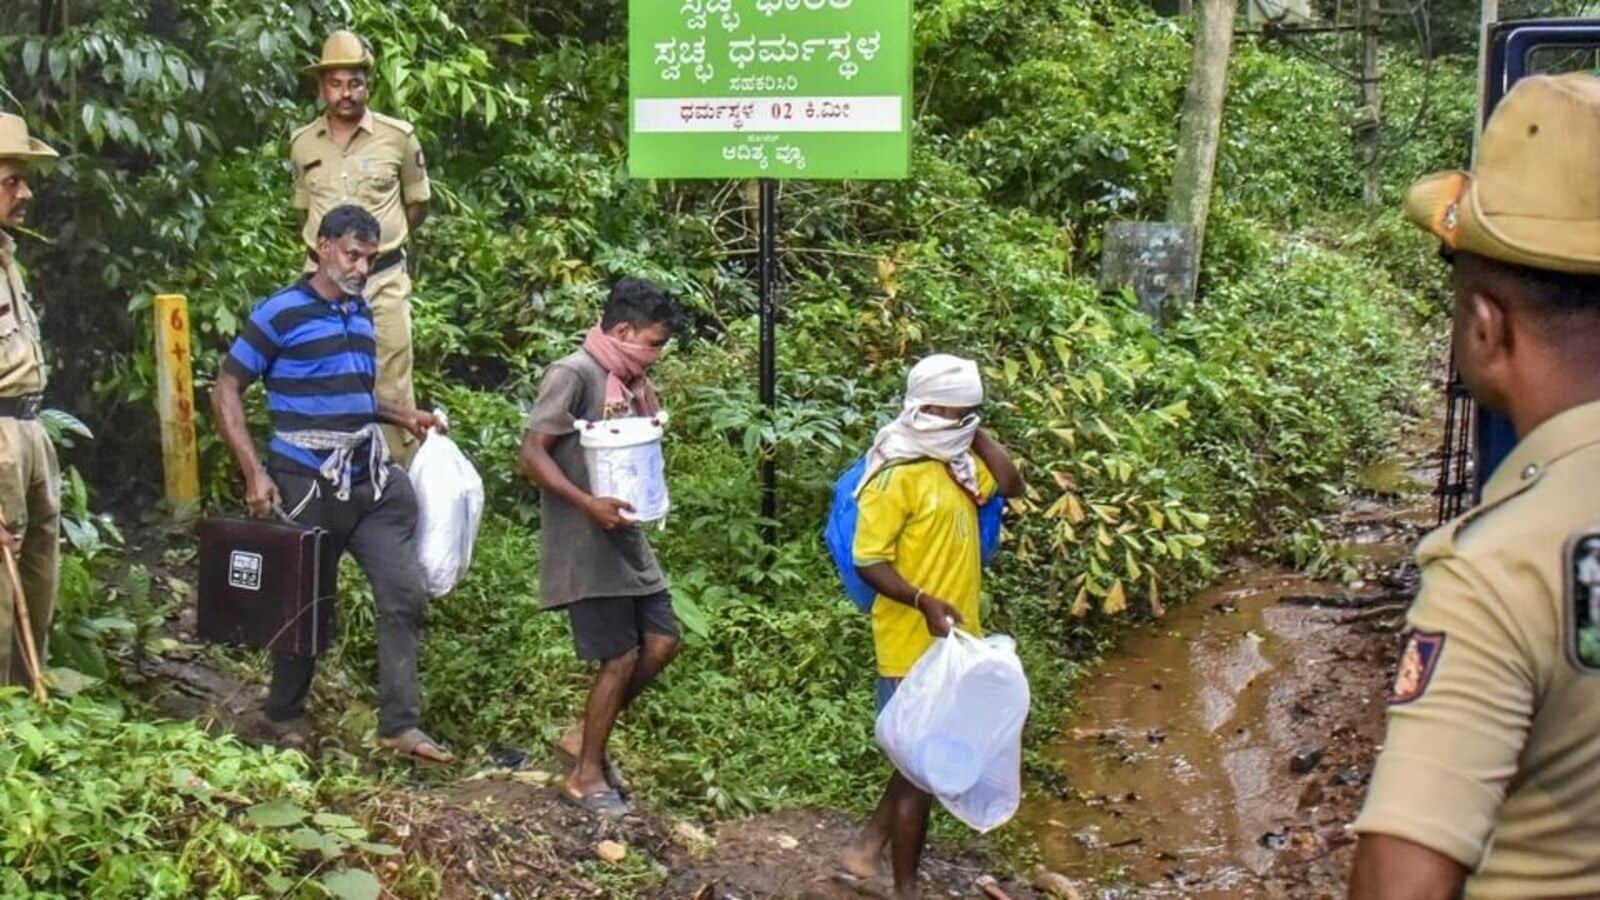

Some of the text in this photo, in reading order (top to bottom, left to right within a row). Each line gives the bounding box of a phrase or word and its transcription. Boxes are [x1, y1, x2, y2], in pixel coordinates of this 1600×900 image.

[654, 30, 881, 83] ಸ್ವಚ್ಛ ಧರ್ಮಸ್ಥಳ
[771, 102, 793, 119] 02
